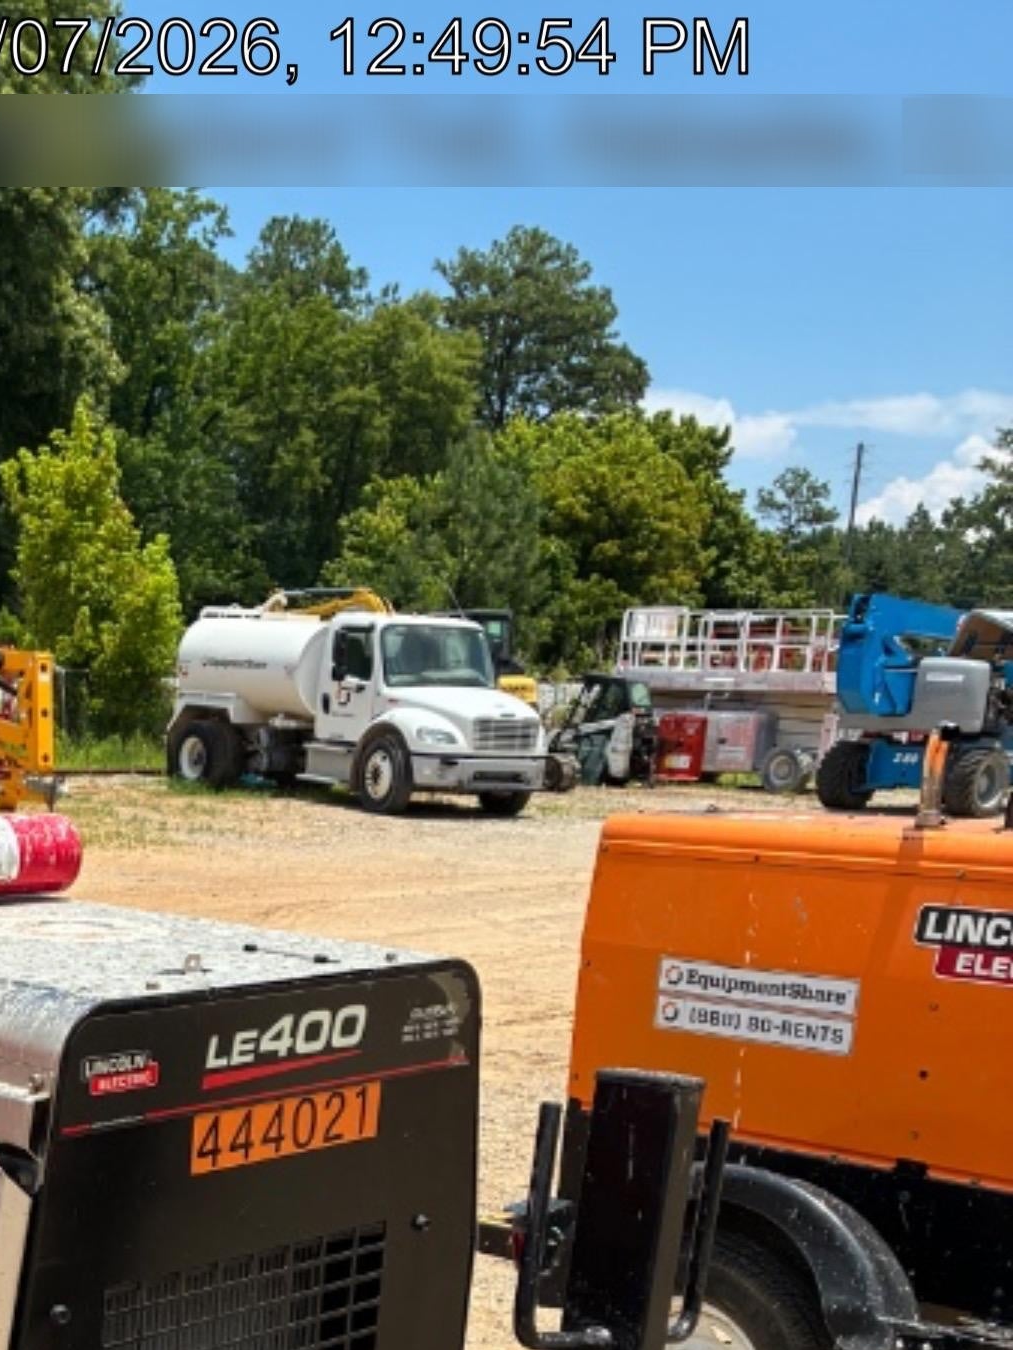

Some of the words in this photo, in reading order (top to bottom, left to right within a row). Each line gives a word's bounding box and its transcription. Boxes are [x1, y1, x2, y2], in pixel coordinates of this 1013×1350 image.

[924, 911, 1013, 947] LINC
[956, 953, 1013, 980] ELE
[686, 969, 847, 1005] EquipmentShare
[205, 1004, 367, 1069] LE400
[196, 1086, 368, 1168] 444021
